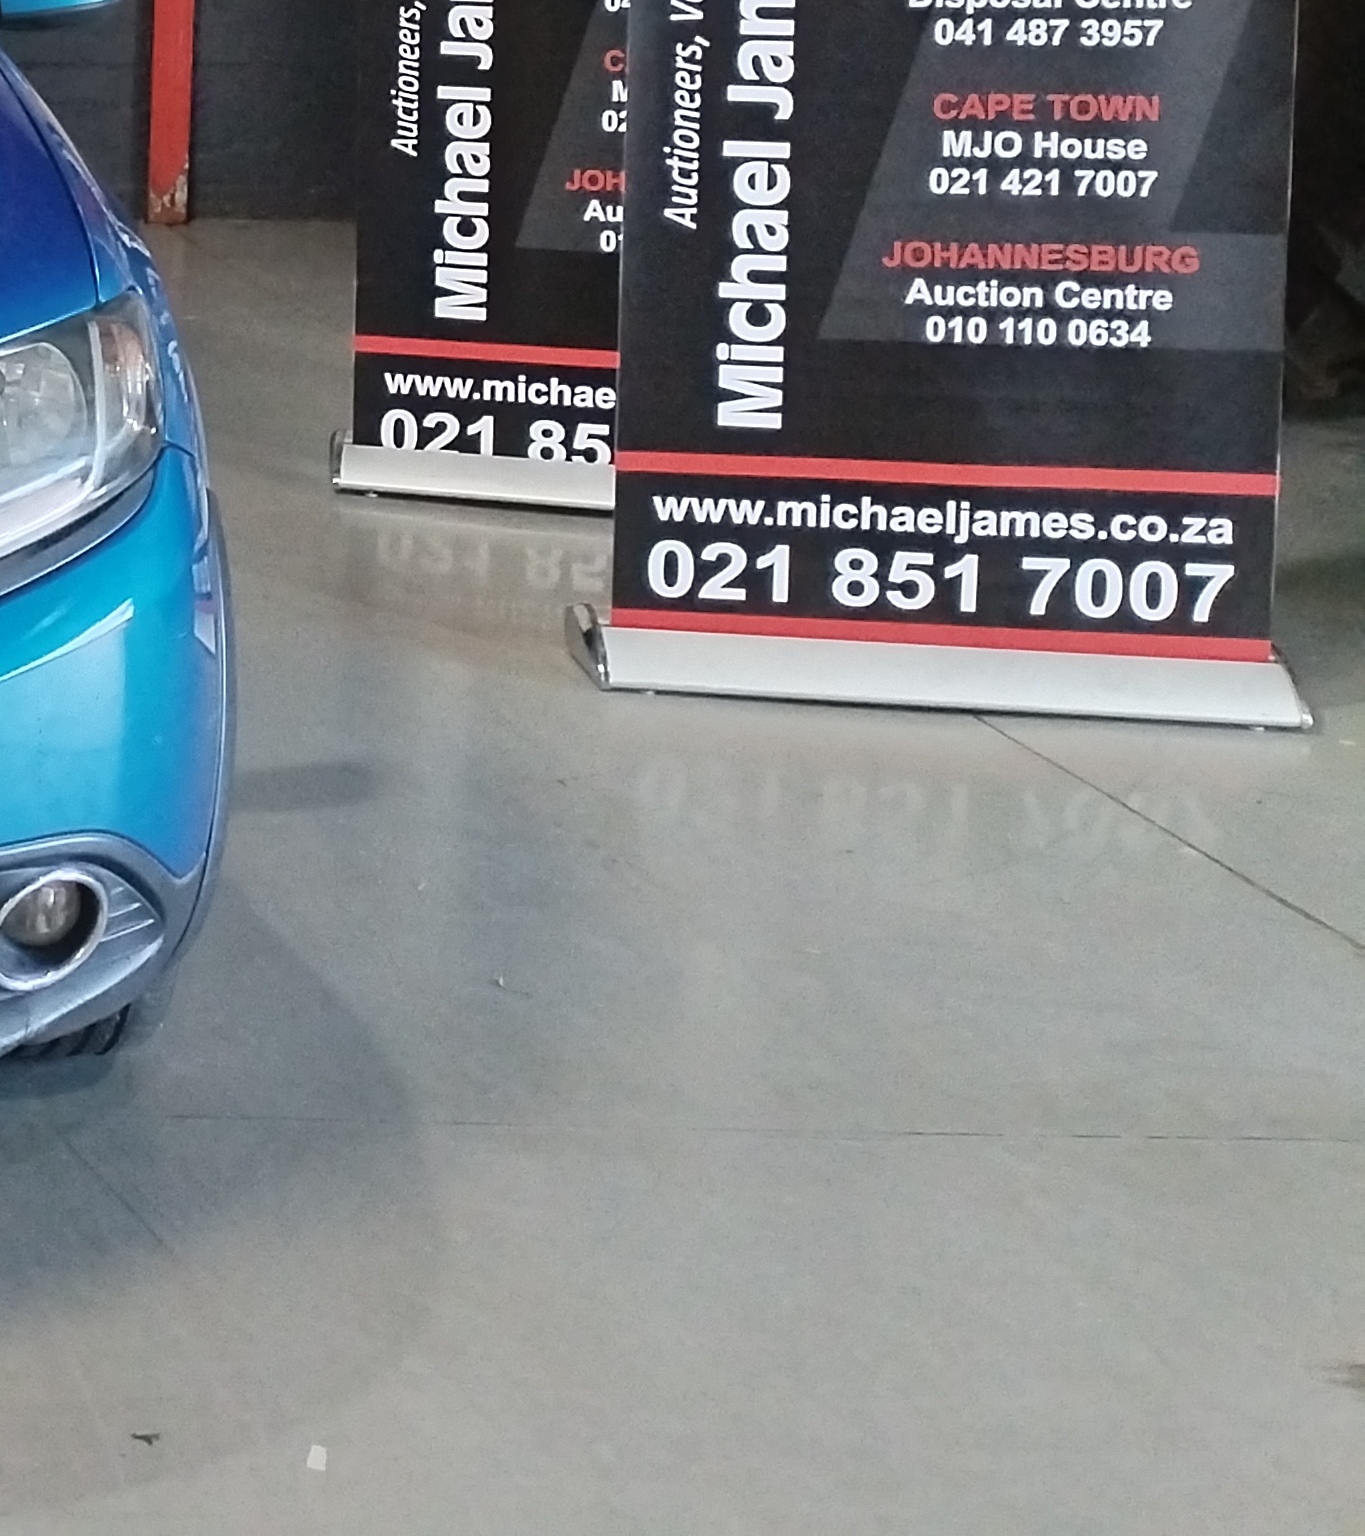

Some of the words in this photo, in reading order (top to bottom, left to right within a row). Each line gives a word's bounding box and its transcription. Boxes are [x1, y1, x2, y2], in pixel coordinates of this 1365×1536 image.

[934, 18, 992, 45] 041
[1006, 19, 1069, 46] 487
[1080, 19, 1163, 46] 3957
[391, 0, 427, 156] Auctioneers,
[933, 93, 1033, 120] CAPE
[1051, 94, 1160, 121] TOWN
[663, 36, 710, 229] Auctioneers,
[943, 130, 1022, 158] MJO
[1034, 131, 1147, 159] House
[434, 85, 493, 321] Michael
[929, 168, 987, 195] 021
[1000, 169, 1059, 195] 421
[1075, 170, 1158, 197] 7007
[884, 241, 1199, 274] JOHANNESBURG
[716, 140, 790, 429] Michael
[905, 278, 1043, 307] Auction
[1054, 281, 1172, 310] Centre
[926, 316, 987, 343] 010
[999, 317, 1056, 345] 110
[1068, 319, 1151, 347] 0634
[380, 408, 495, 456] 021
[527, 418, 611, 465] 85
[652, 495, 1233, 550] www.michaeljames.co.za
[648, 540, 789, 602] 021
[832, 548, 978, 612] 851
[1022, 557, 1234, 622] 7007
